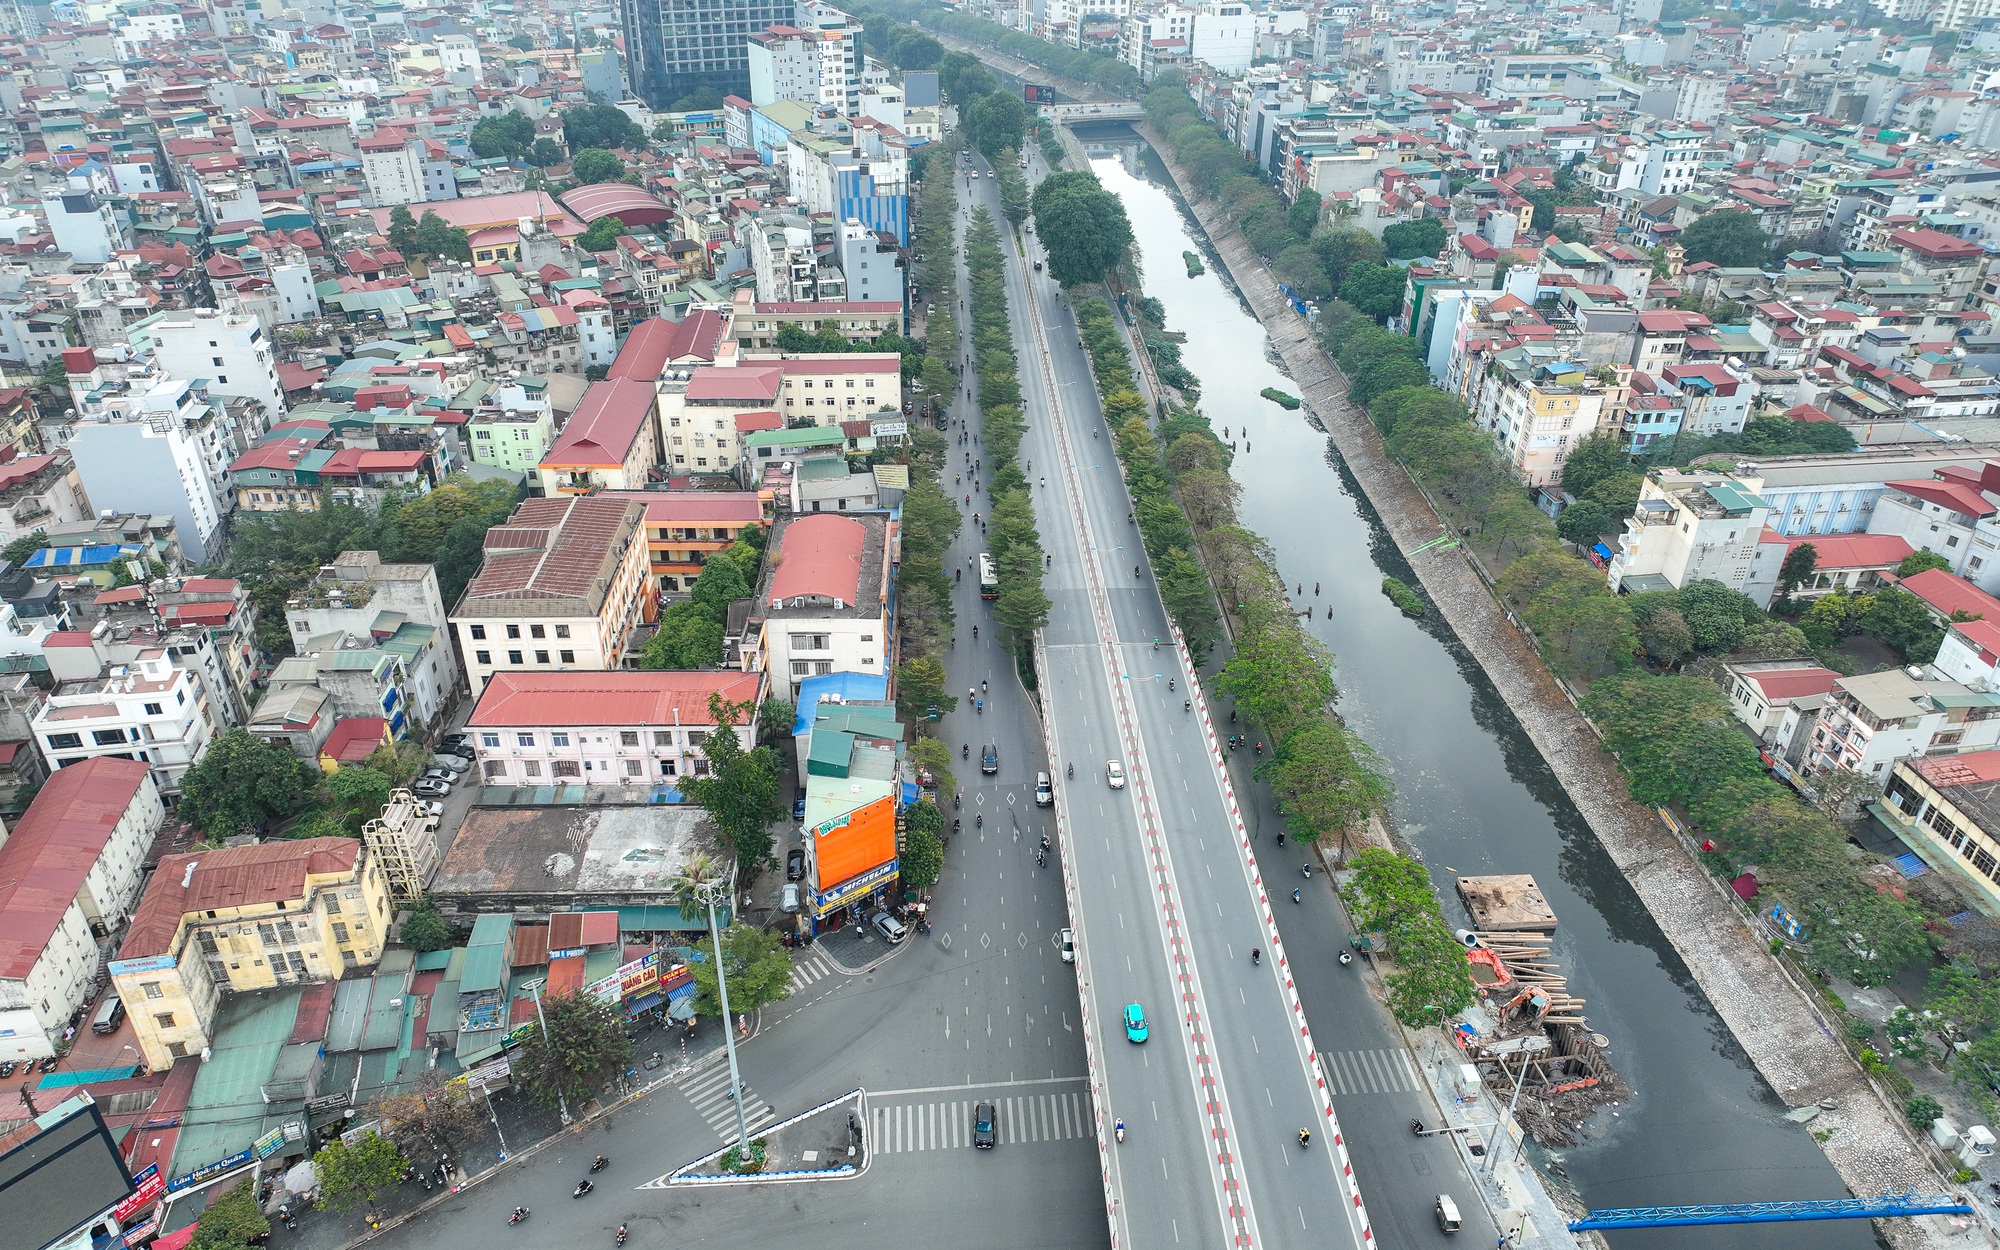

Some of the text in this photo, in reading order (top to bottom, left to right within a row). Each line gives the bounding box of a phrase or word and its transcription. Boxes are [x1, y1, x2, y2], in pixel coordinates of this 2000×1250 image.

[816, 42, 825, 87] HOTEL
[841, 865, 892, 893] MICHELIN
[643, 953, 659, 966] LED
[621, 975, 642, 992] QUẢNG
[642, 968, 656, 981] CÁO
[140, 1176, 161, 1193] MOTOR
